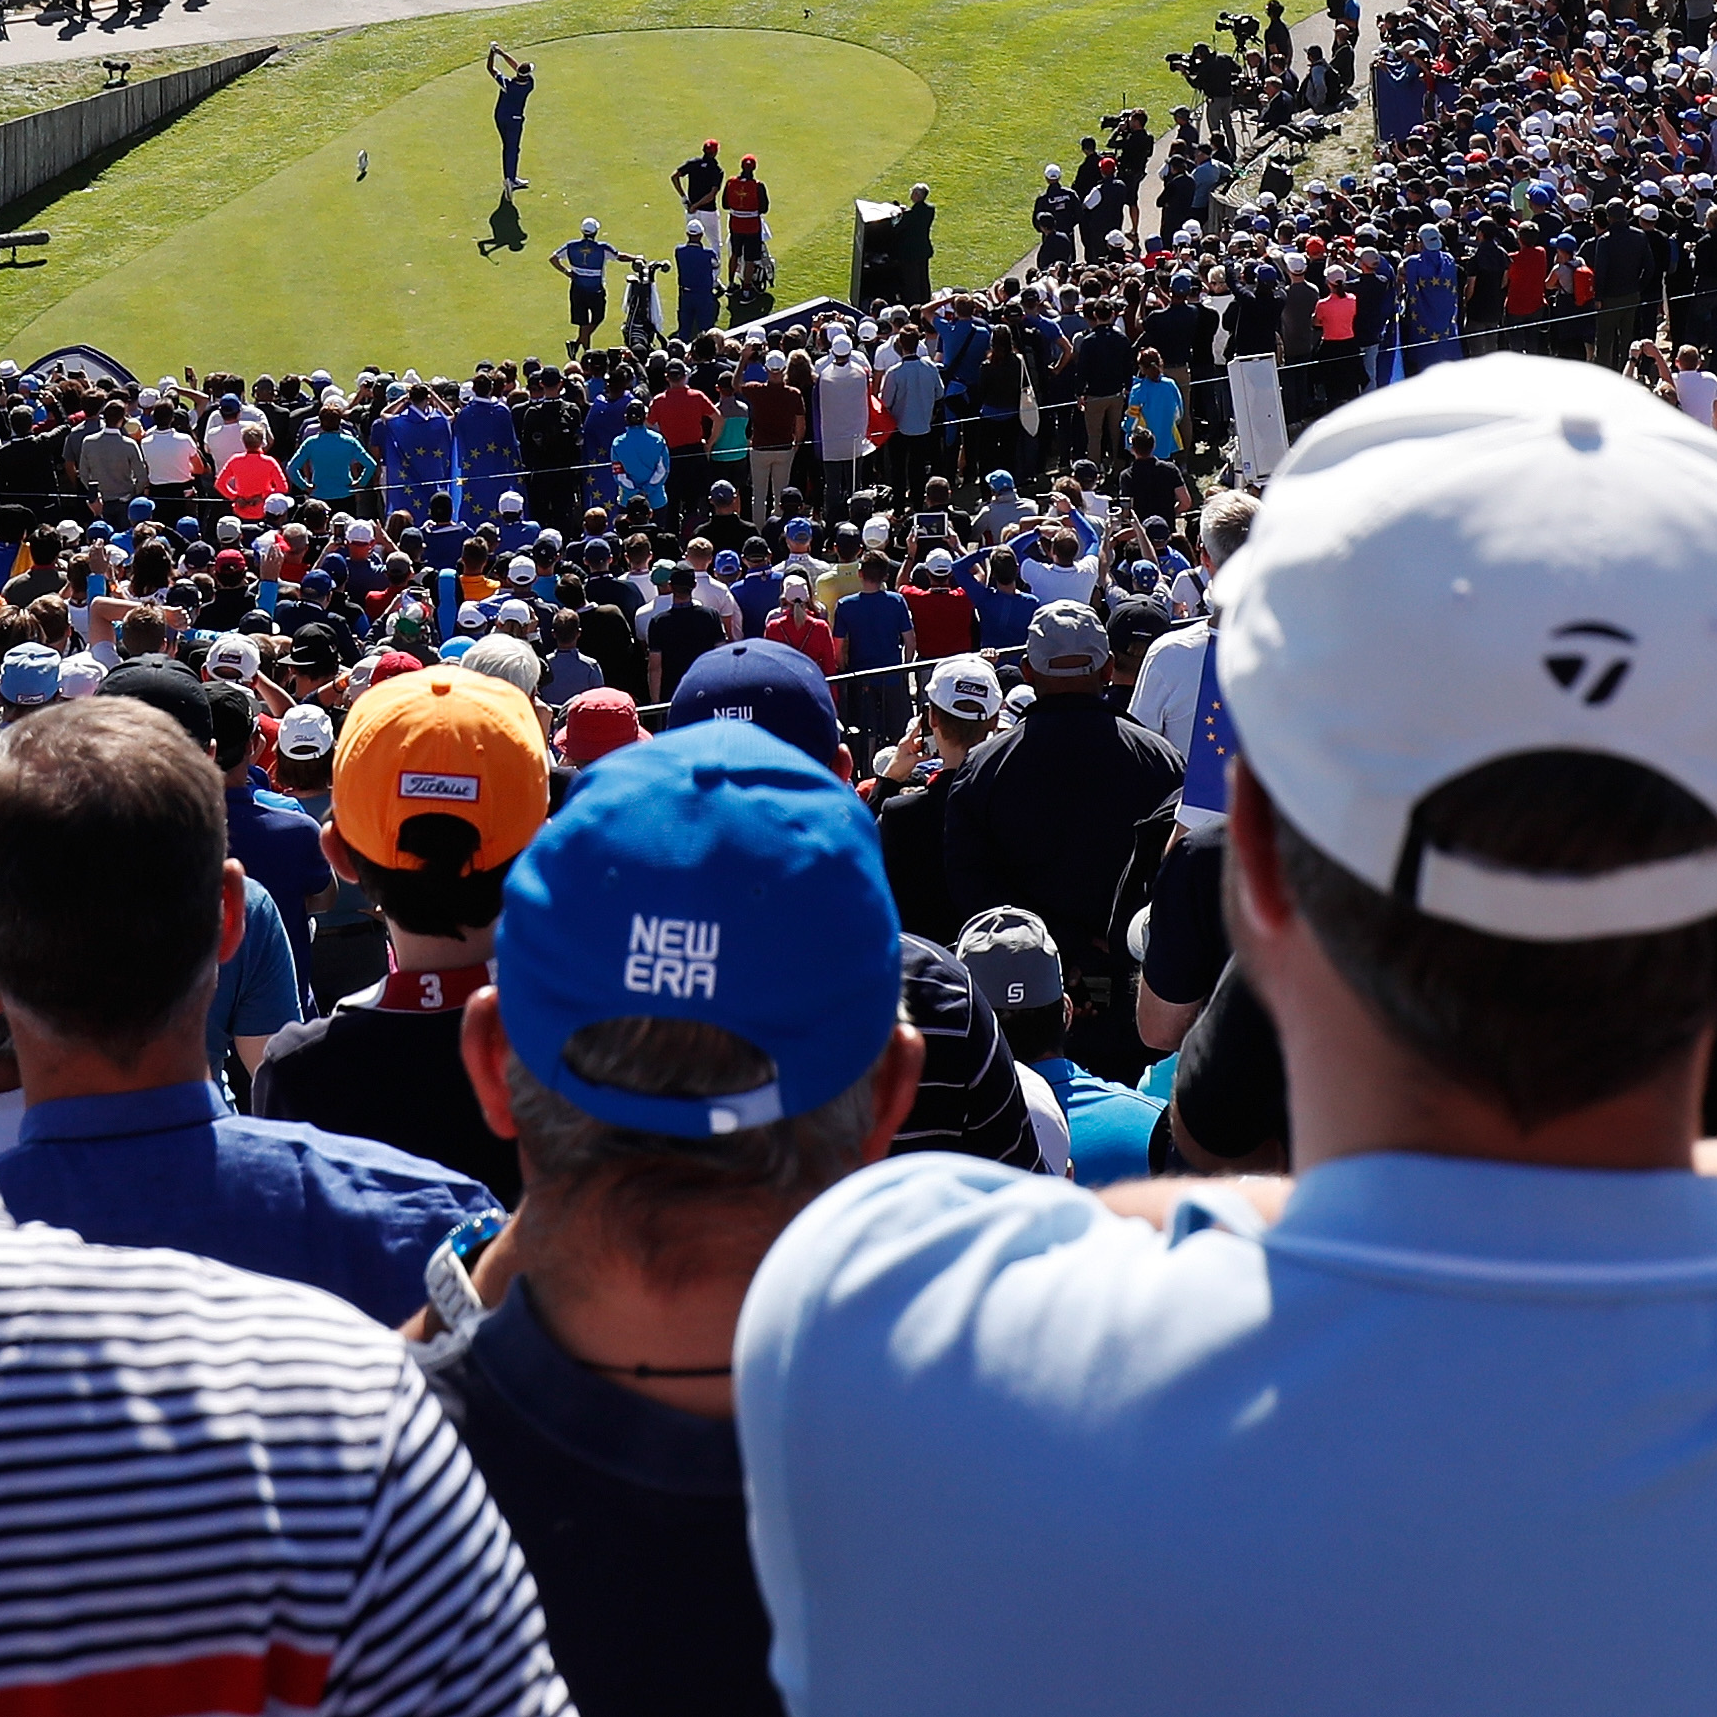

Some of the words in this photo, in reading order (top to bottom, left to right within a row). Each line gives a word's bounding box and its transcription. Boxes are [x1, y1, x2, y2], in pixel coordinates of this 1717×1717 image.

[405, 776, 471, 797] Titleist
[629, 913, 720, 961] NEW
[624, 954, 717, 1000] ERA
